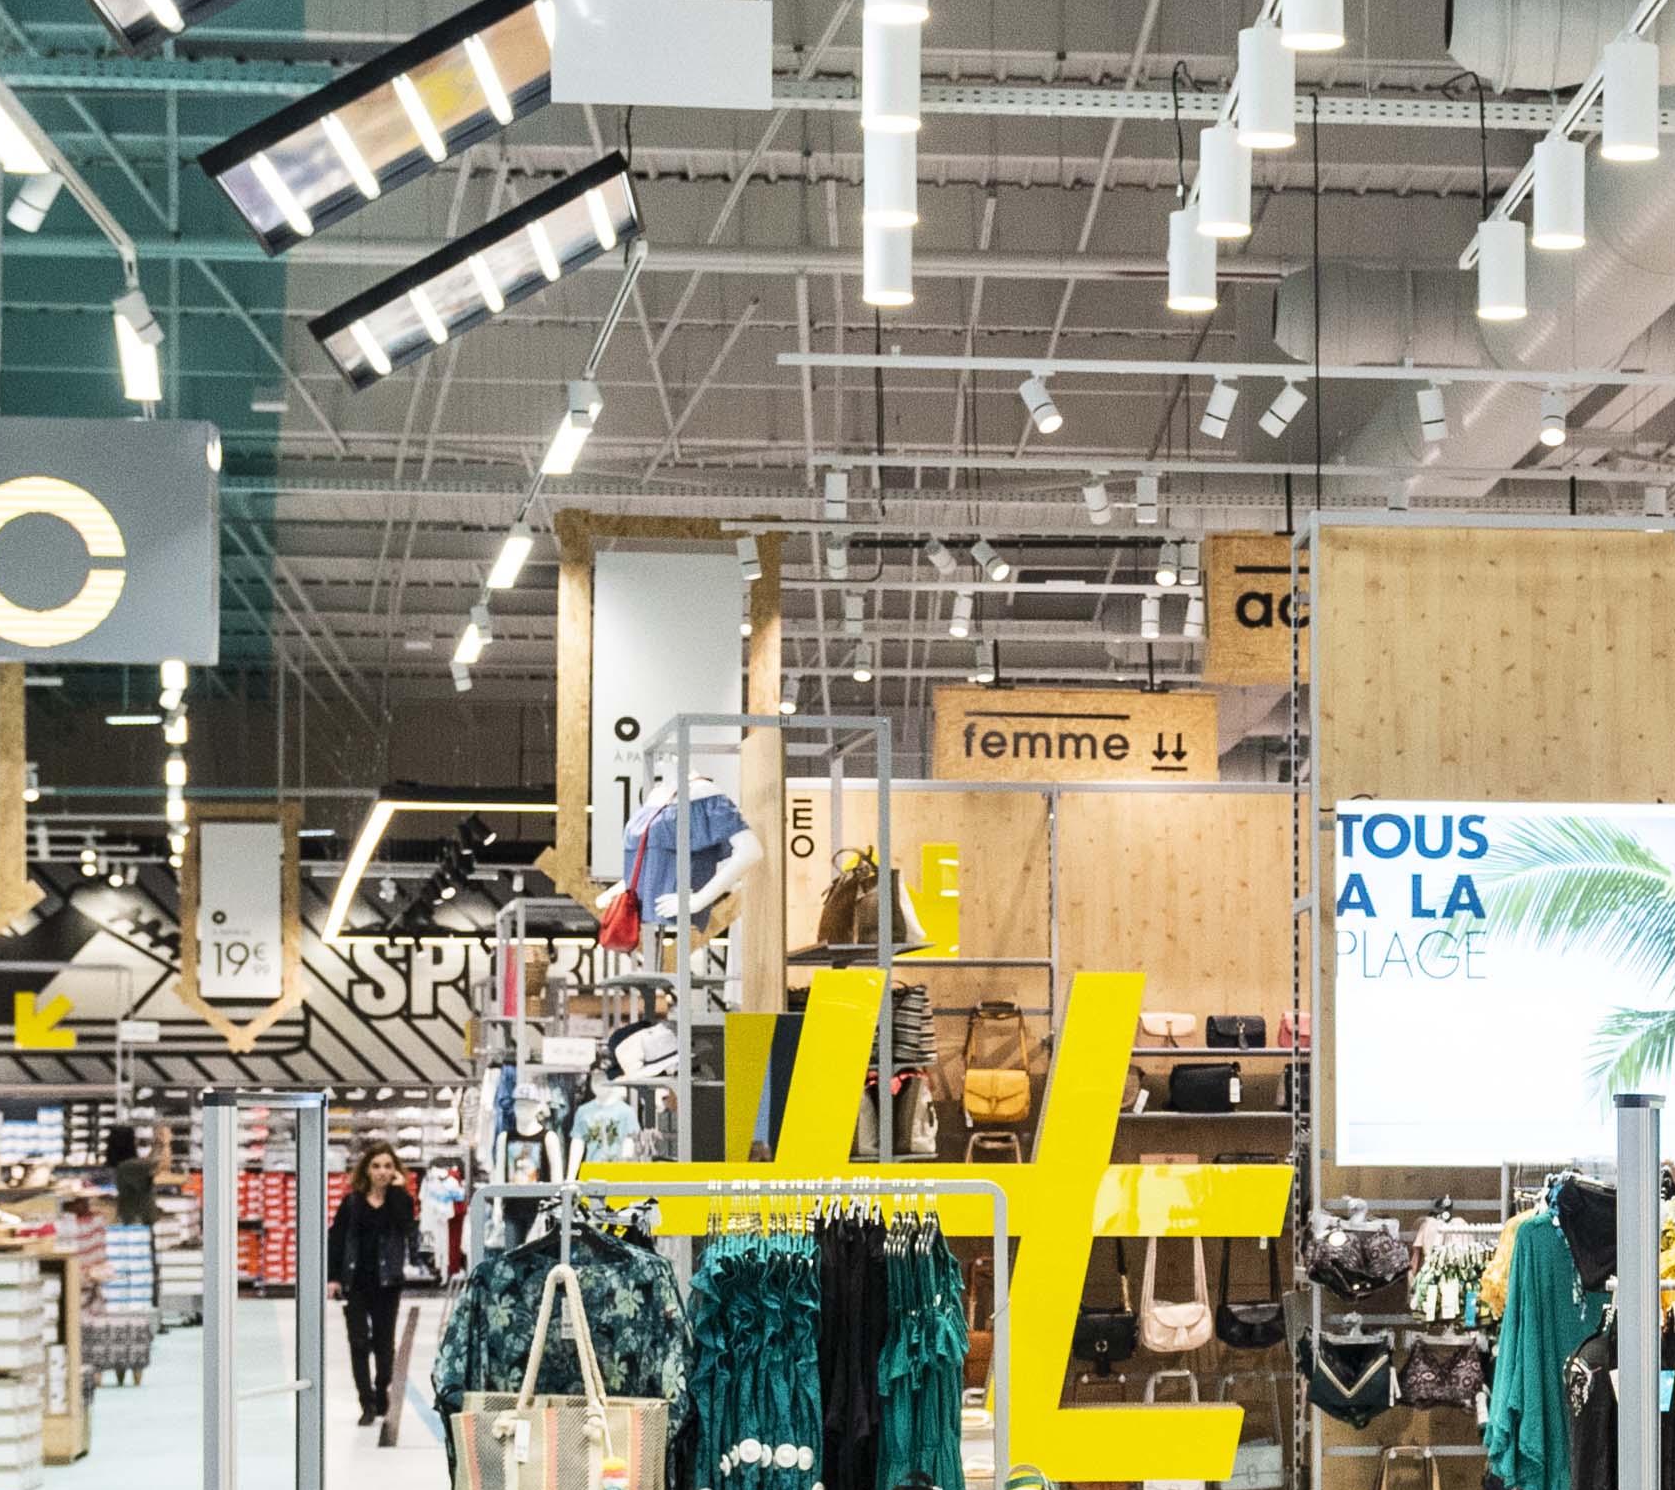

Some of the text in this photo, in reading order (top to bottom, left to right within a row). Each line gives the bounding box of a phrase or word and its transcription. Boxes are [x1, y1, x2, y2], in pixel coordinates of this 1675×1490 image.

[963, 722, 1130, 760] femme
[1337, 813, 1488, 859] TOUS
[1412, 874, 1487, 919] LA
[1337, 929, 1487, 979] PLAGE
